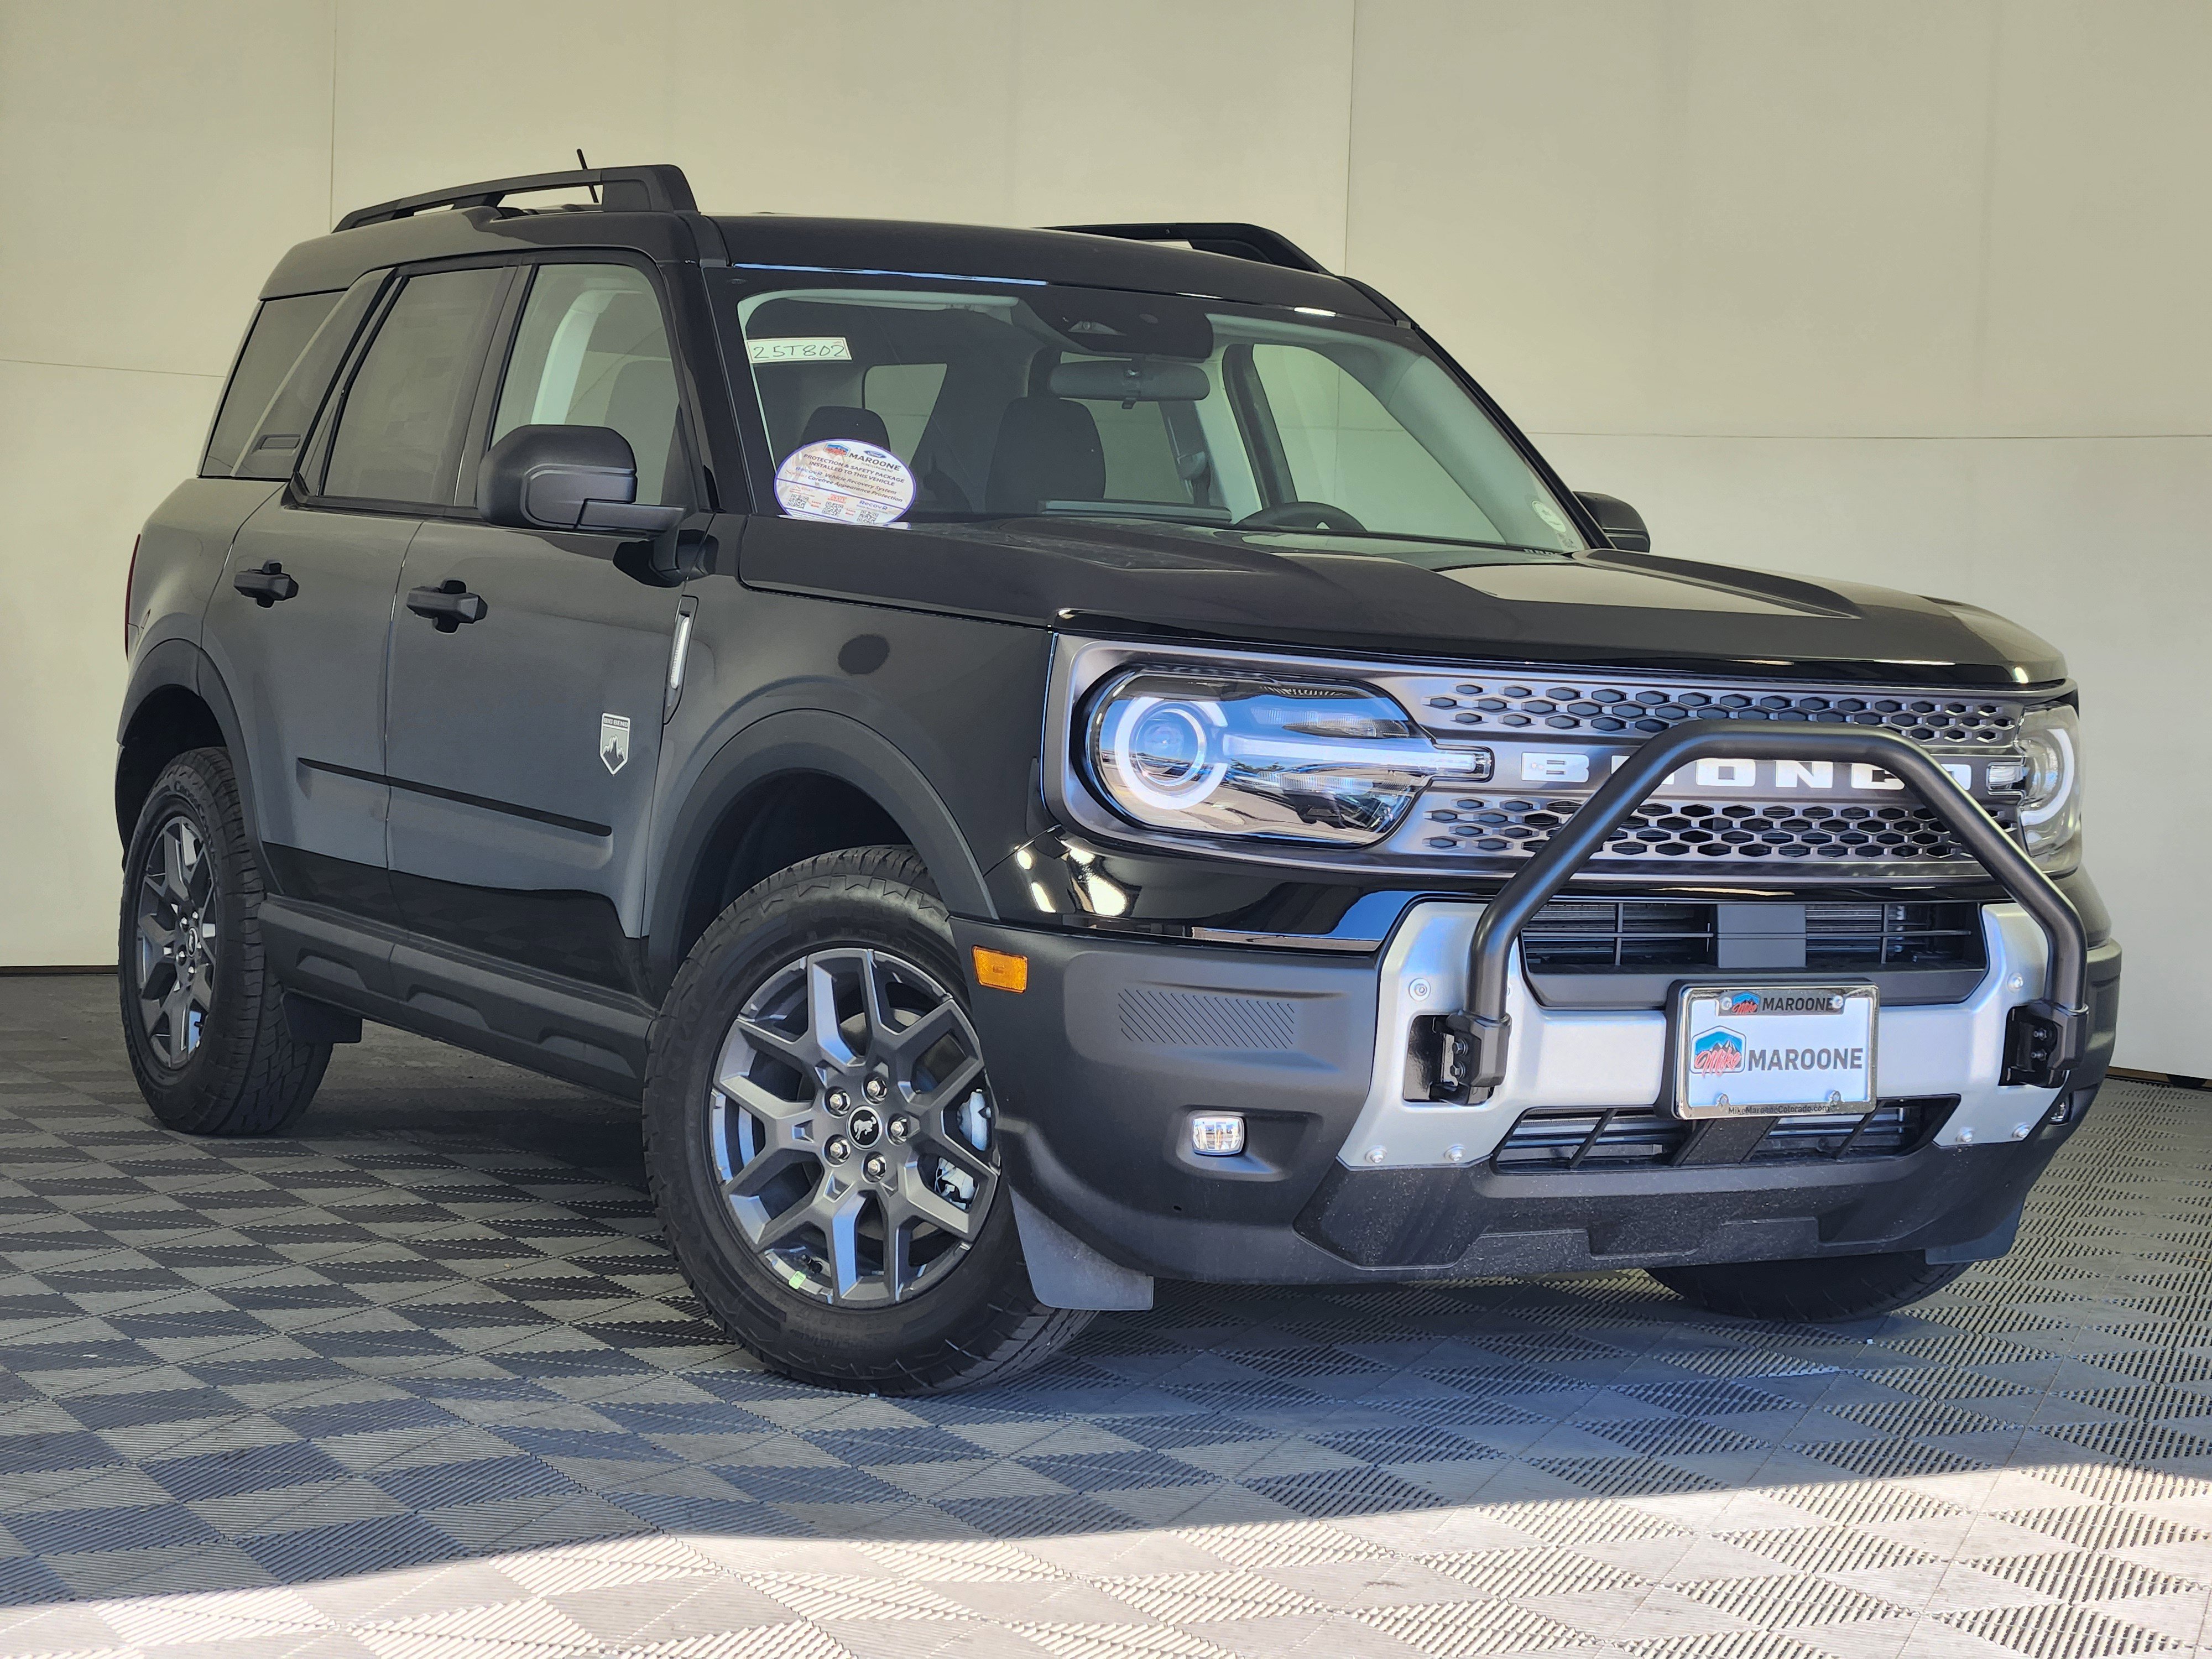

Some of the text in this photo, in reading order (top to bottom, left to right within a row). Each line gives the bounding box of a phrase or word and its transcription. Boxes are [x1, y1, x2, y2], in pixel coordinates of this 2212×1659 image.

[754, 345, 846, 358] 25T802
[804, 454, 843, 467] PROTECTION
[850, 465, 874, 474] SAFETY
[875, 472, 905, 483] PACKAGE
[849, 452, 901, 471] MAROONE
[809, 461, 843, 472] INSTALLED
[869, 476, 895, 486] VEHICLE
[825, 473, 846, 482] Vehicle
[847, 478, 874, 489] Recovery
[875, 486, 896, 494] System
[808, 475, 902, 502] Carefree Appearance Protection
[859, 500, 888, 510] RecovR
[1521, 752, 1971, 790] BONC
[1694, 1046, 1863, 1078] Mike MAROONE
[1728, 1104, 1830, 1115] MikeMarooneColorado.com
